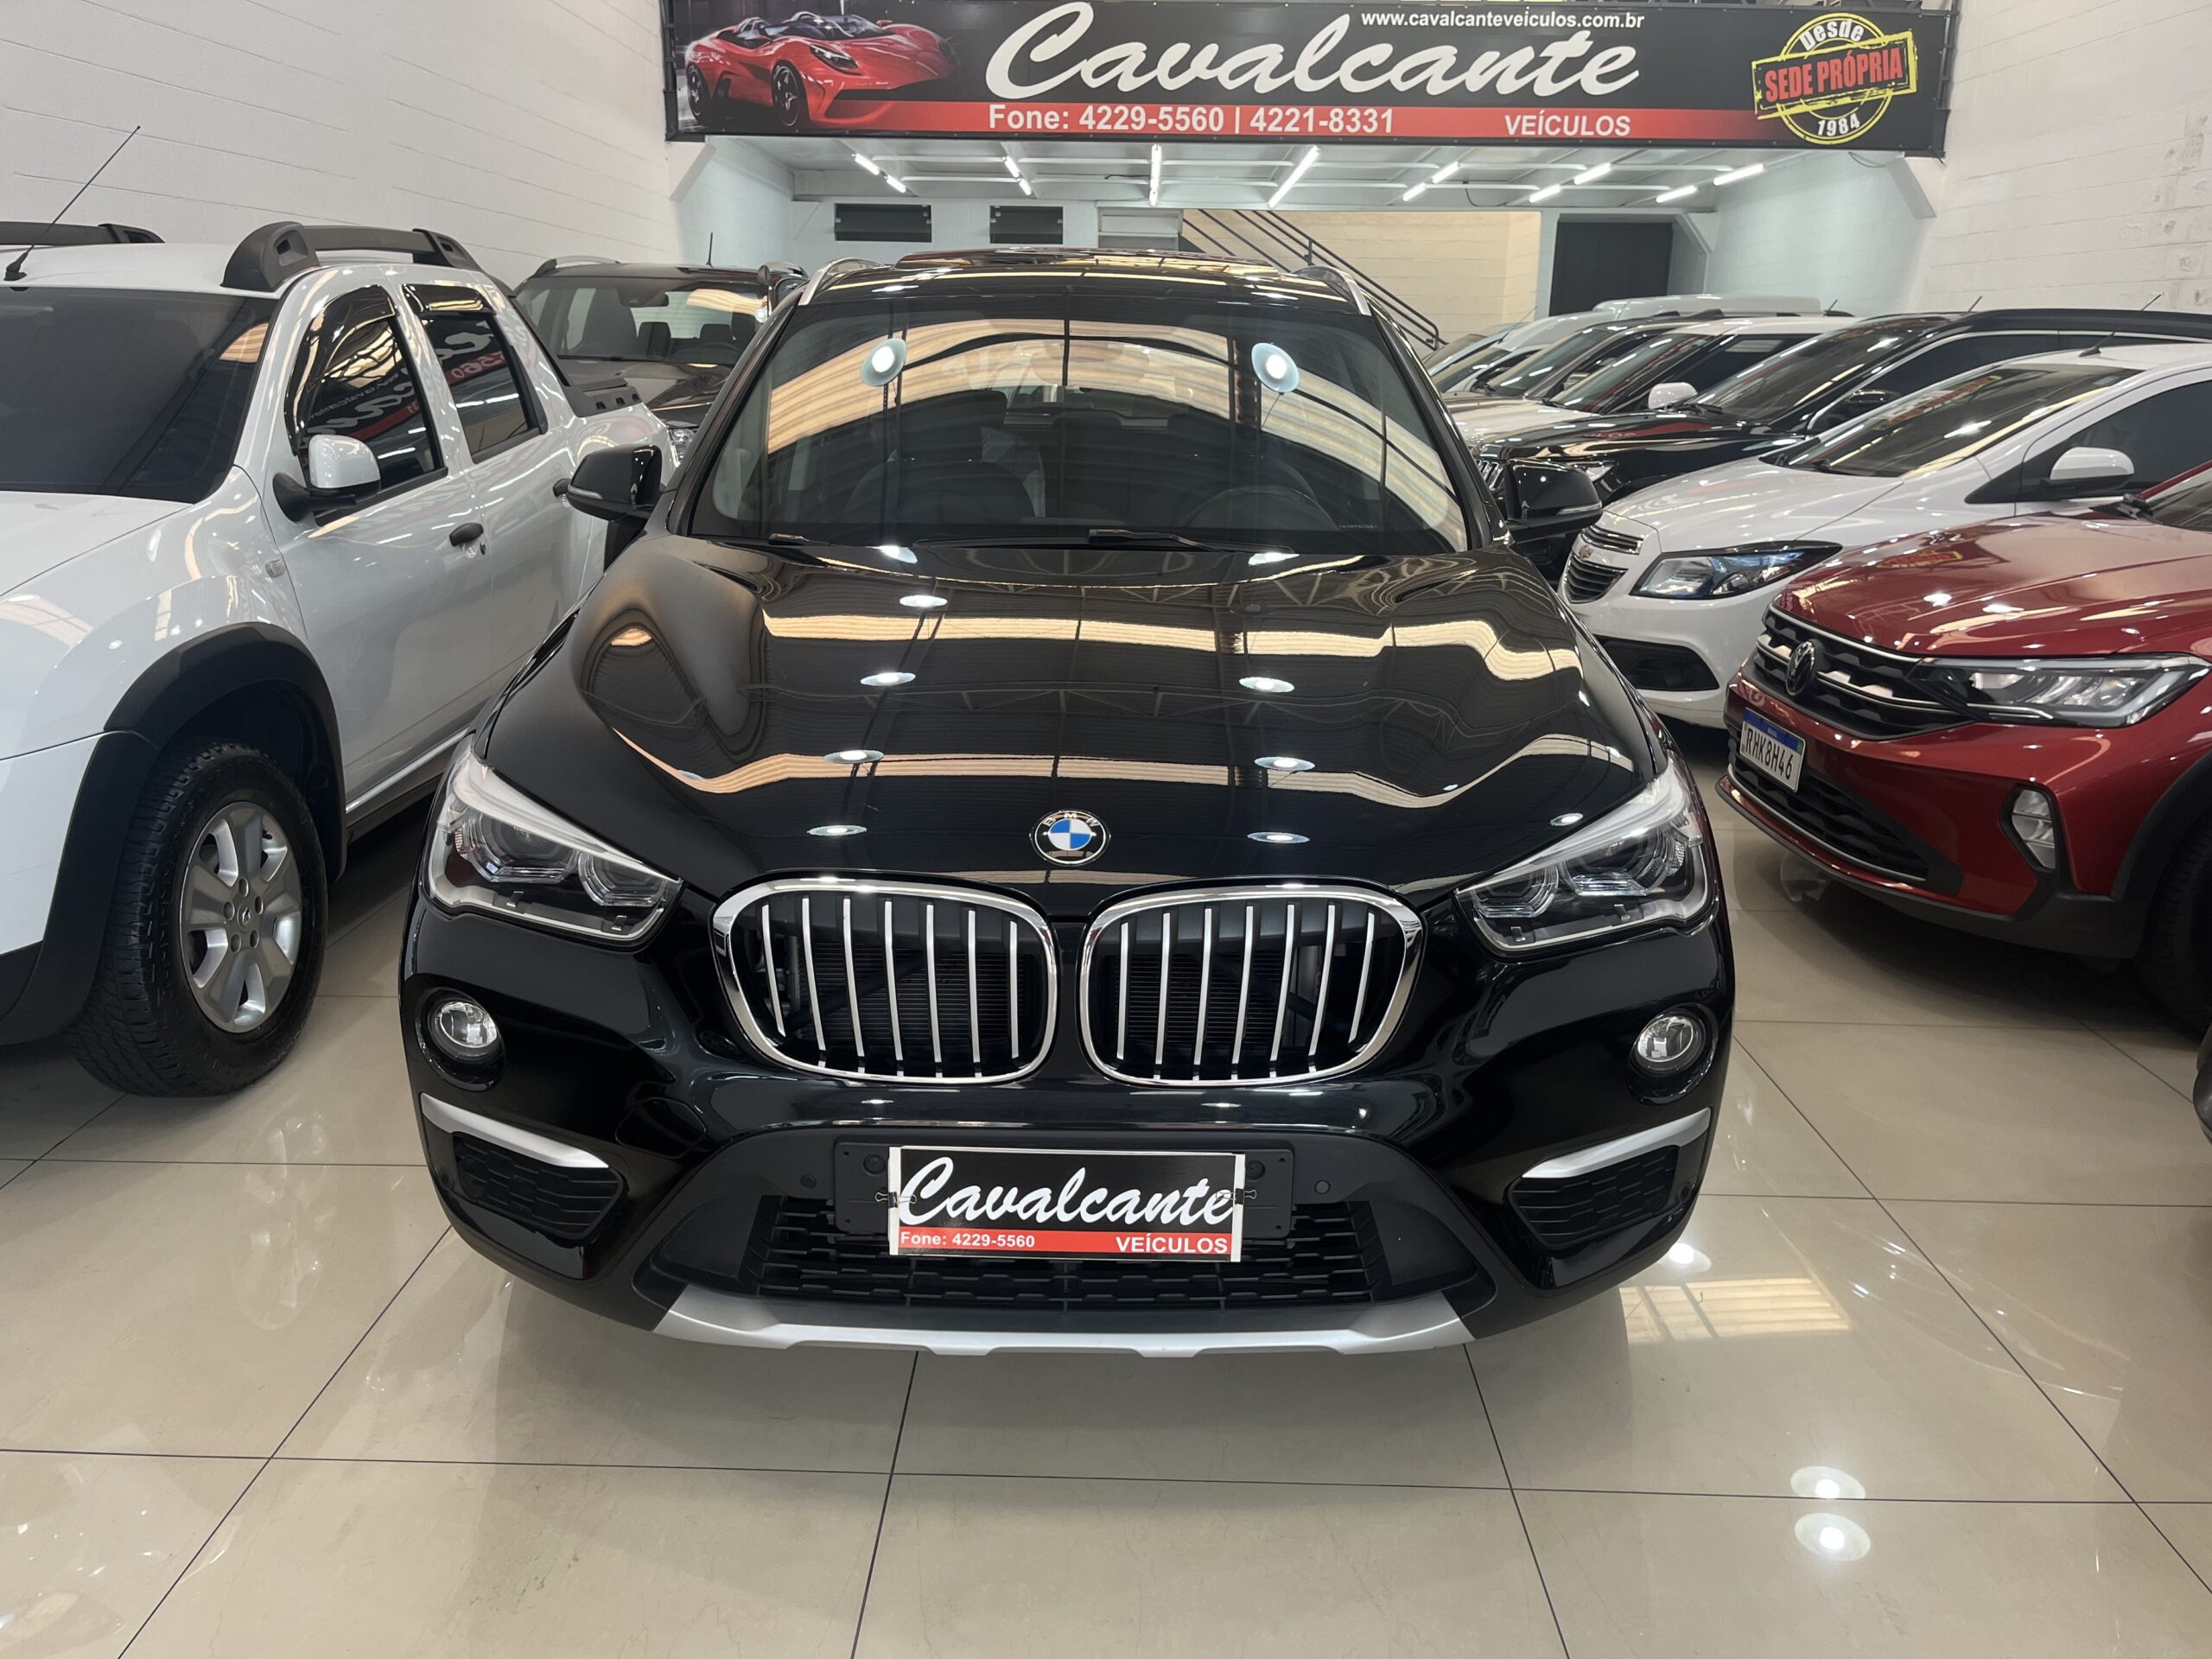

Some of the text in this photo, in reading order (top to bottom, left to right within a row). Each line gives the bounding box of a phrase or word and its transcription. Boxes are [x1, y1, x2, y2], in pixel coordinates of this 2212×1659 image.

[1799, 19, 1865, 51] Desde
[985, 2, 1639, 99] Cavalcante
[1764, 49, 1903, 103] SEDE PRÓPRIA
[988, 104, 1069, 130] Fone:
[1078, 105, 1224, 133] 4229-5560
[1249, 107, 1394, 134] 4221-8331
[1504, 109, 1631, 137] VEÍCULOS
[1817, 112, 1860, 137] 1984
[1745, 728, 1793, 780] RHK8H46
[1042, 812, 1100, 827] BMW
[899, 1156, 1233, 1225] Cavalcante
[900, 1231, 1035, 1249] Fone: 4229-5560
[1116, 1232, 1228, 1254] VEÍCULOS
